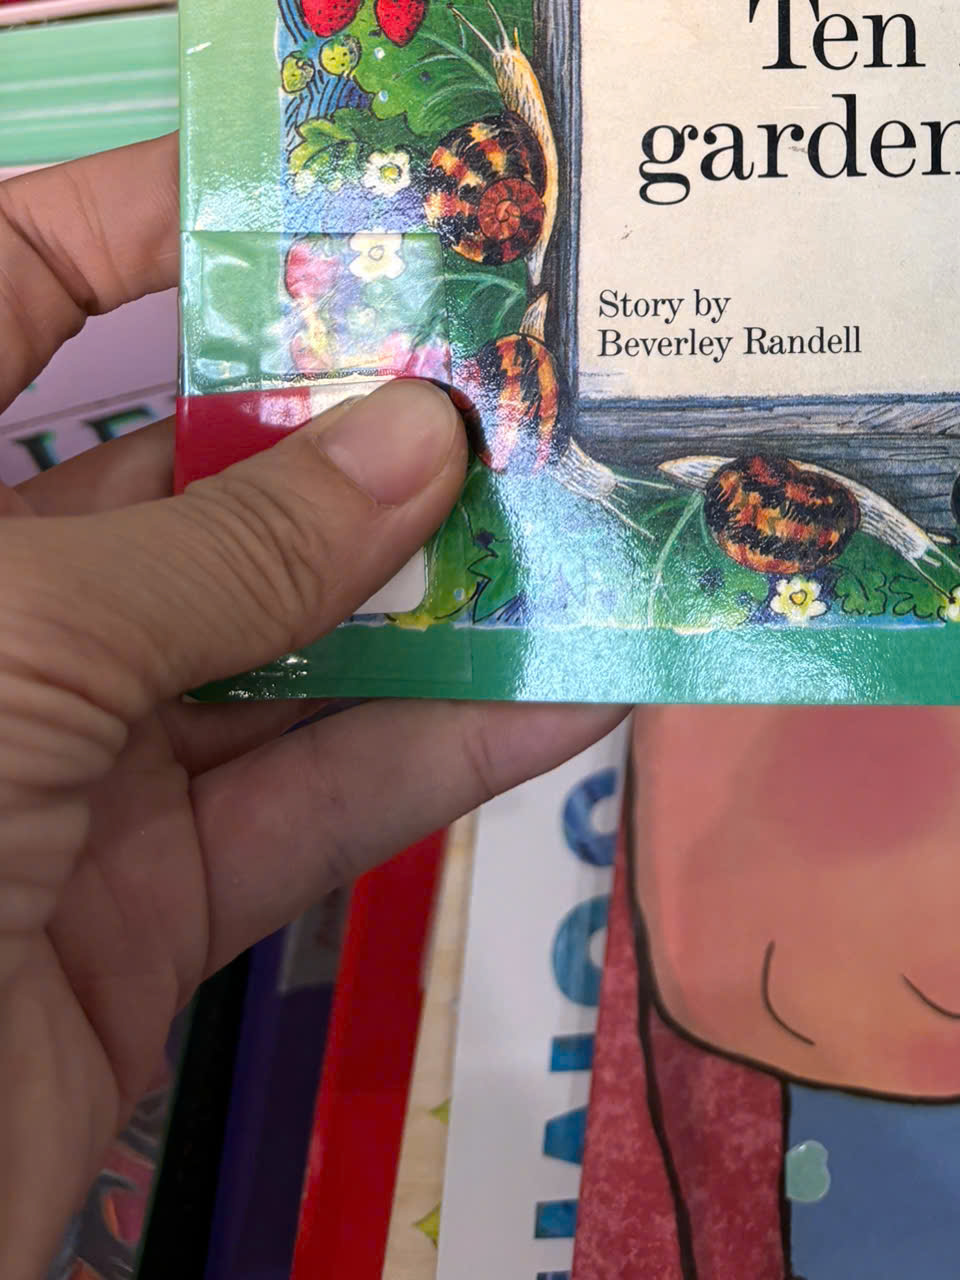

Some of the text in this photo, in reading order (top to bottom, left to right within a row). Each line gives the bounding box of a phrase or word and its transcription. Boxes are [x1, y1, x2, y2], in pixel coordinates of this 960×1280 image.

[598, 287, 732, 324] Story by
[597, 324, 863, 363] Beverley Randell
